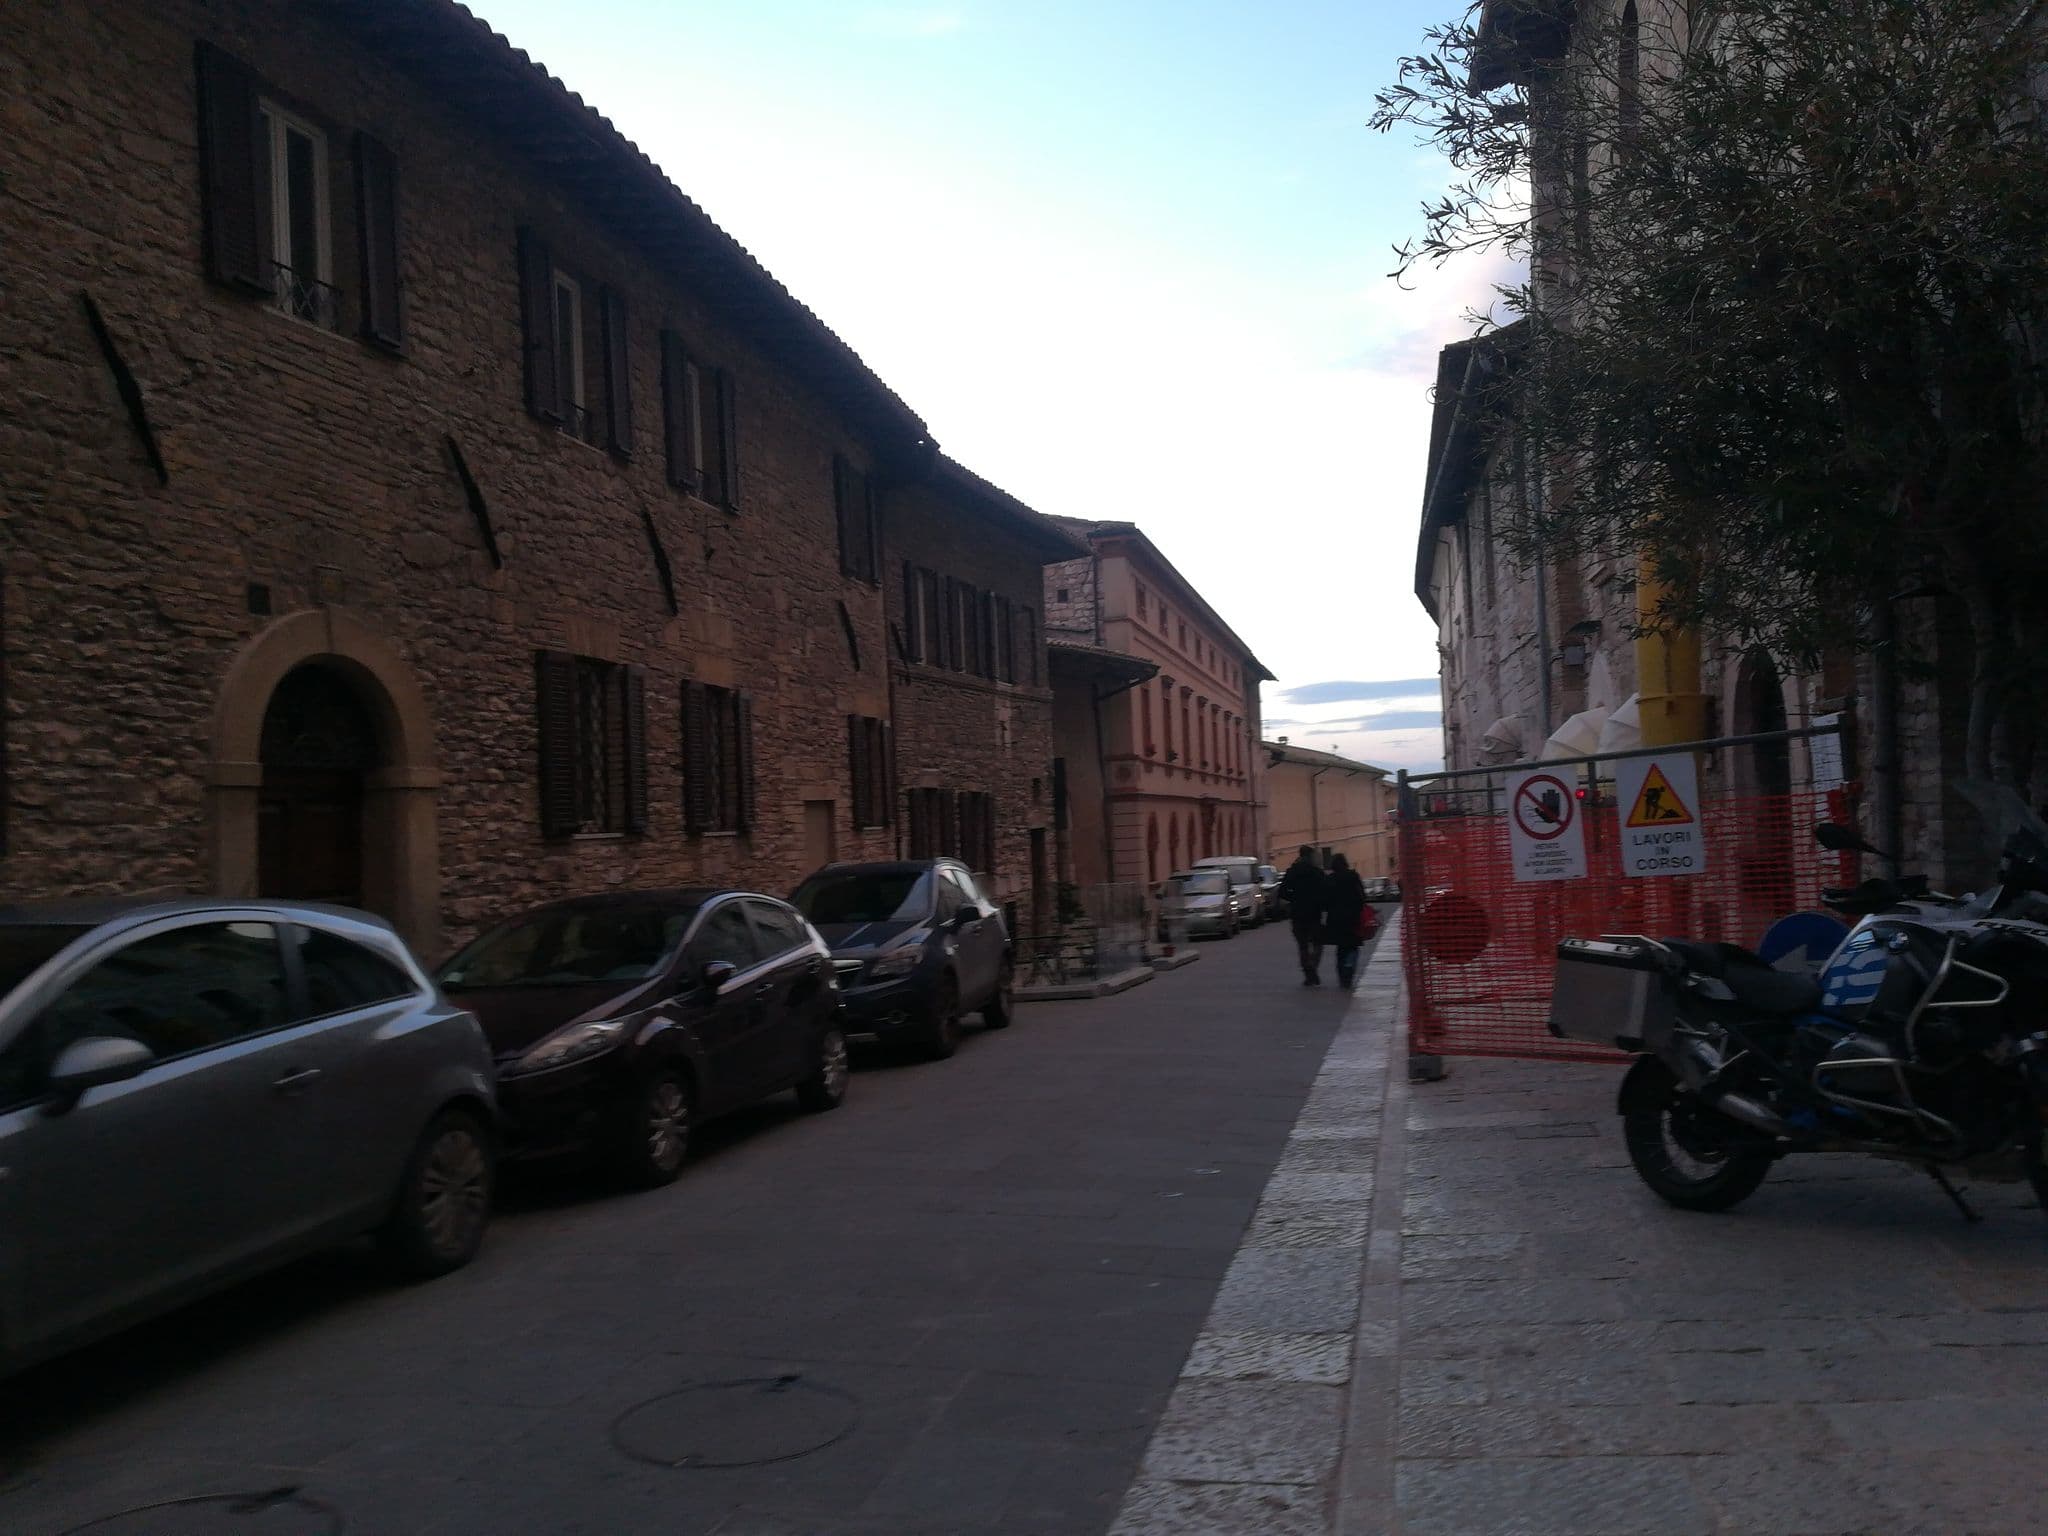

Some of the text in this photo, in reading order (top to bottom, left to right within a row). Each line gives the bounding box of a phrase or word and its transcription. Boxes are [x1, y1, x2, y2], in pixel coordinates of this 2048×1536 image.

[1631, 831, 1691, 846] LAVORI
[1655, 846, 1670, 855] IN
[1636, 855, 1693, 870] CORSO
